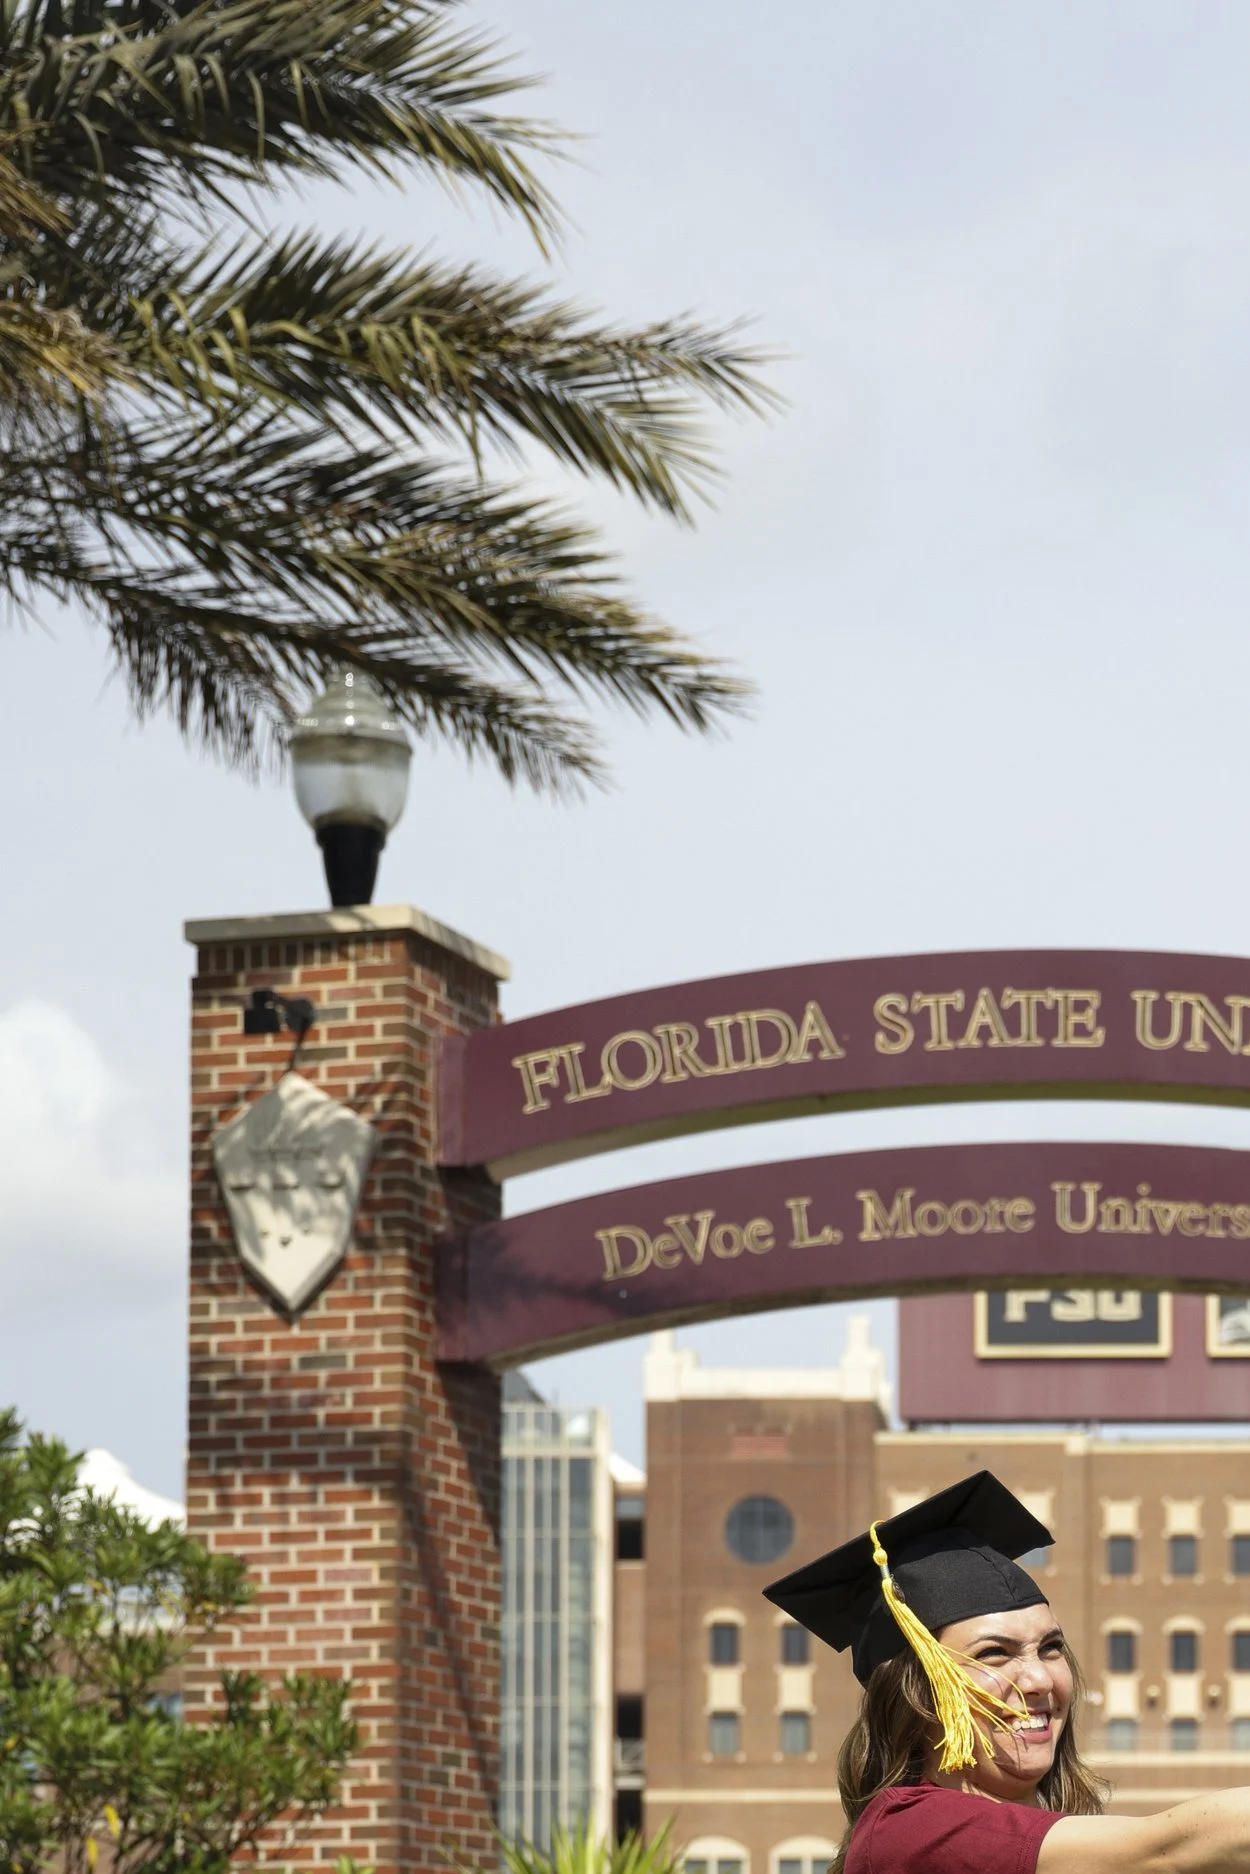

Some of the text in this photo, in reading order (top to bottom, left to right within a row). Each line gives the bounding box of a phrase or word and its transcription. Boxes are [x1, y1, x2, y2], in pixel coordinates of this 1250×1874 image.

[511, 1001, 845, 1114] FLORIDA
[873, 987, 1105, 1055] STATE
[595, 1210, 775, 1282] DeVoe
[785, 1198, 843, 1249] L.
[856, 1188, 1035, 1242] Moore
